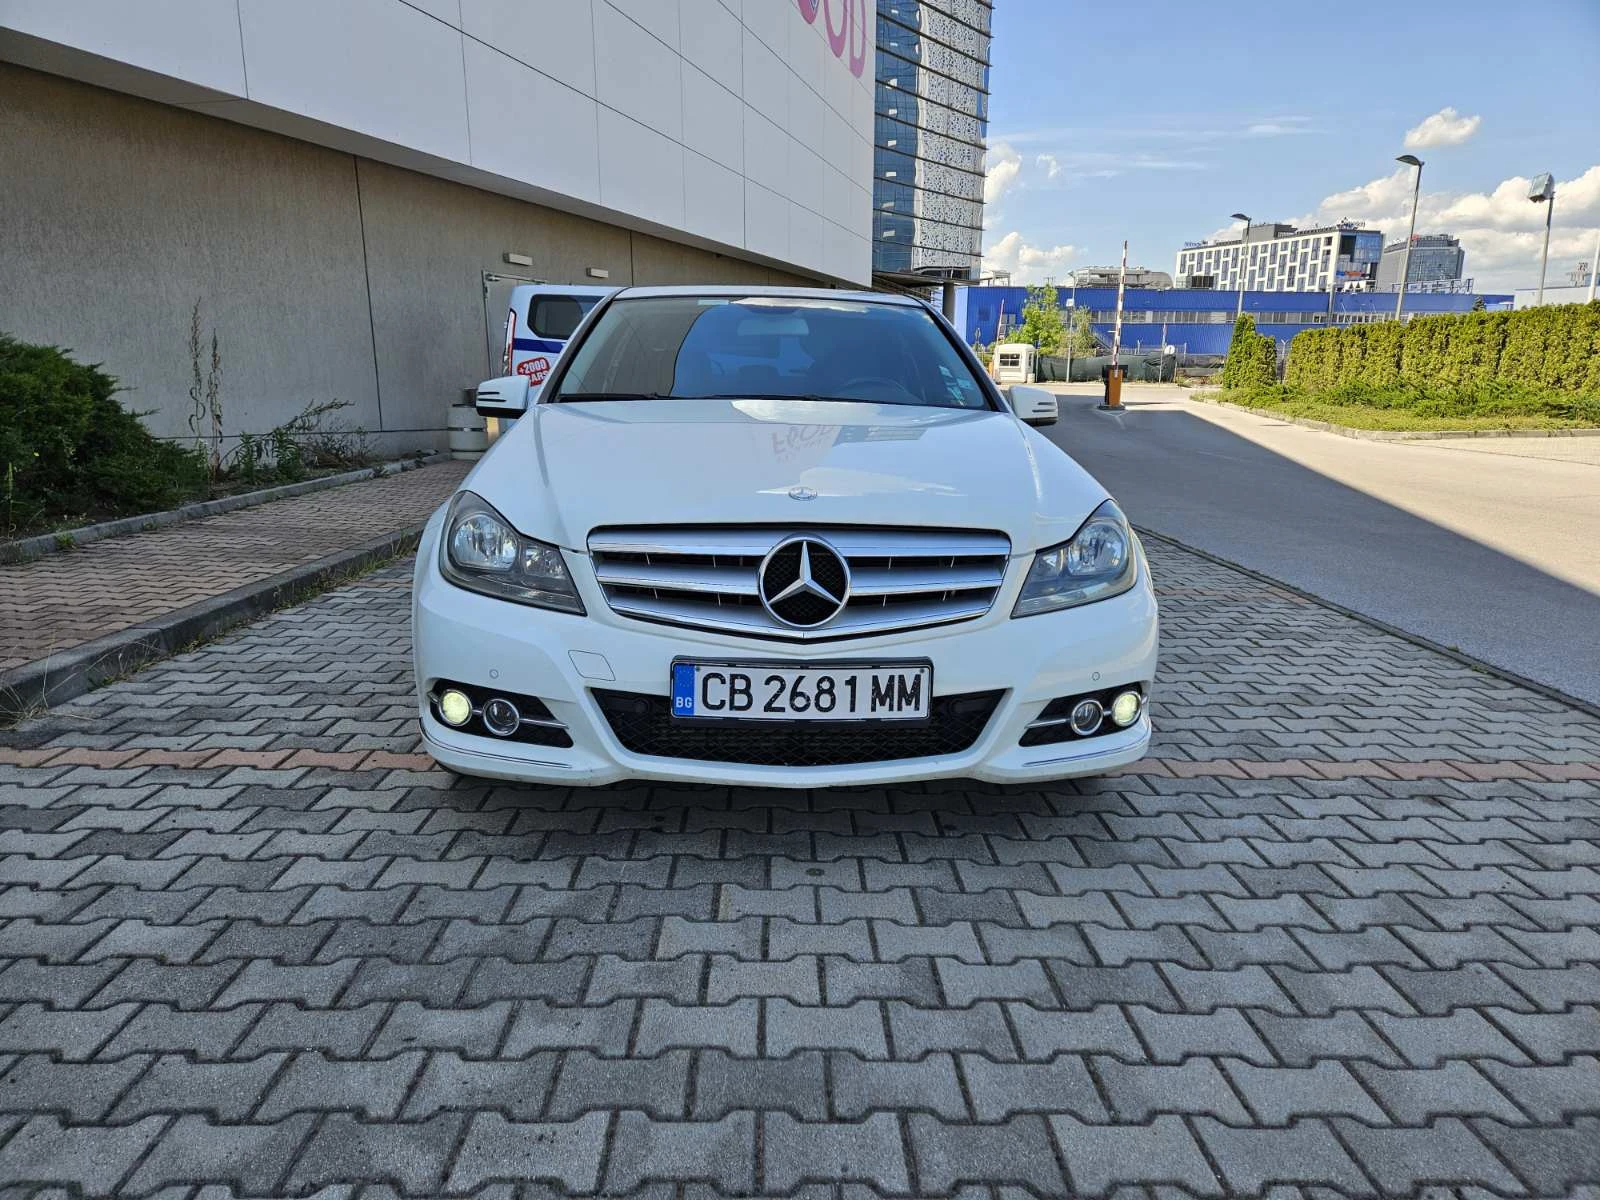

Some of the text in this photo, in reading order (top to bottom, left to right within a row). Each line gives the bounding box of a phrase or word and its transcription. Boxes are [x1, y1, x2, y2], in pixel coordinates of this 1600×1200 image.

[531, 370, 548, 383] ARS
[701, 672, 922, 713] CB 2681 MM
[675, 696, 693, 708] BG
